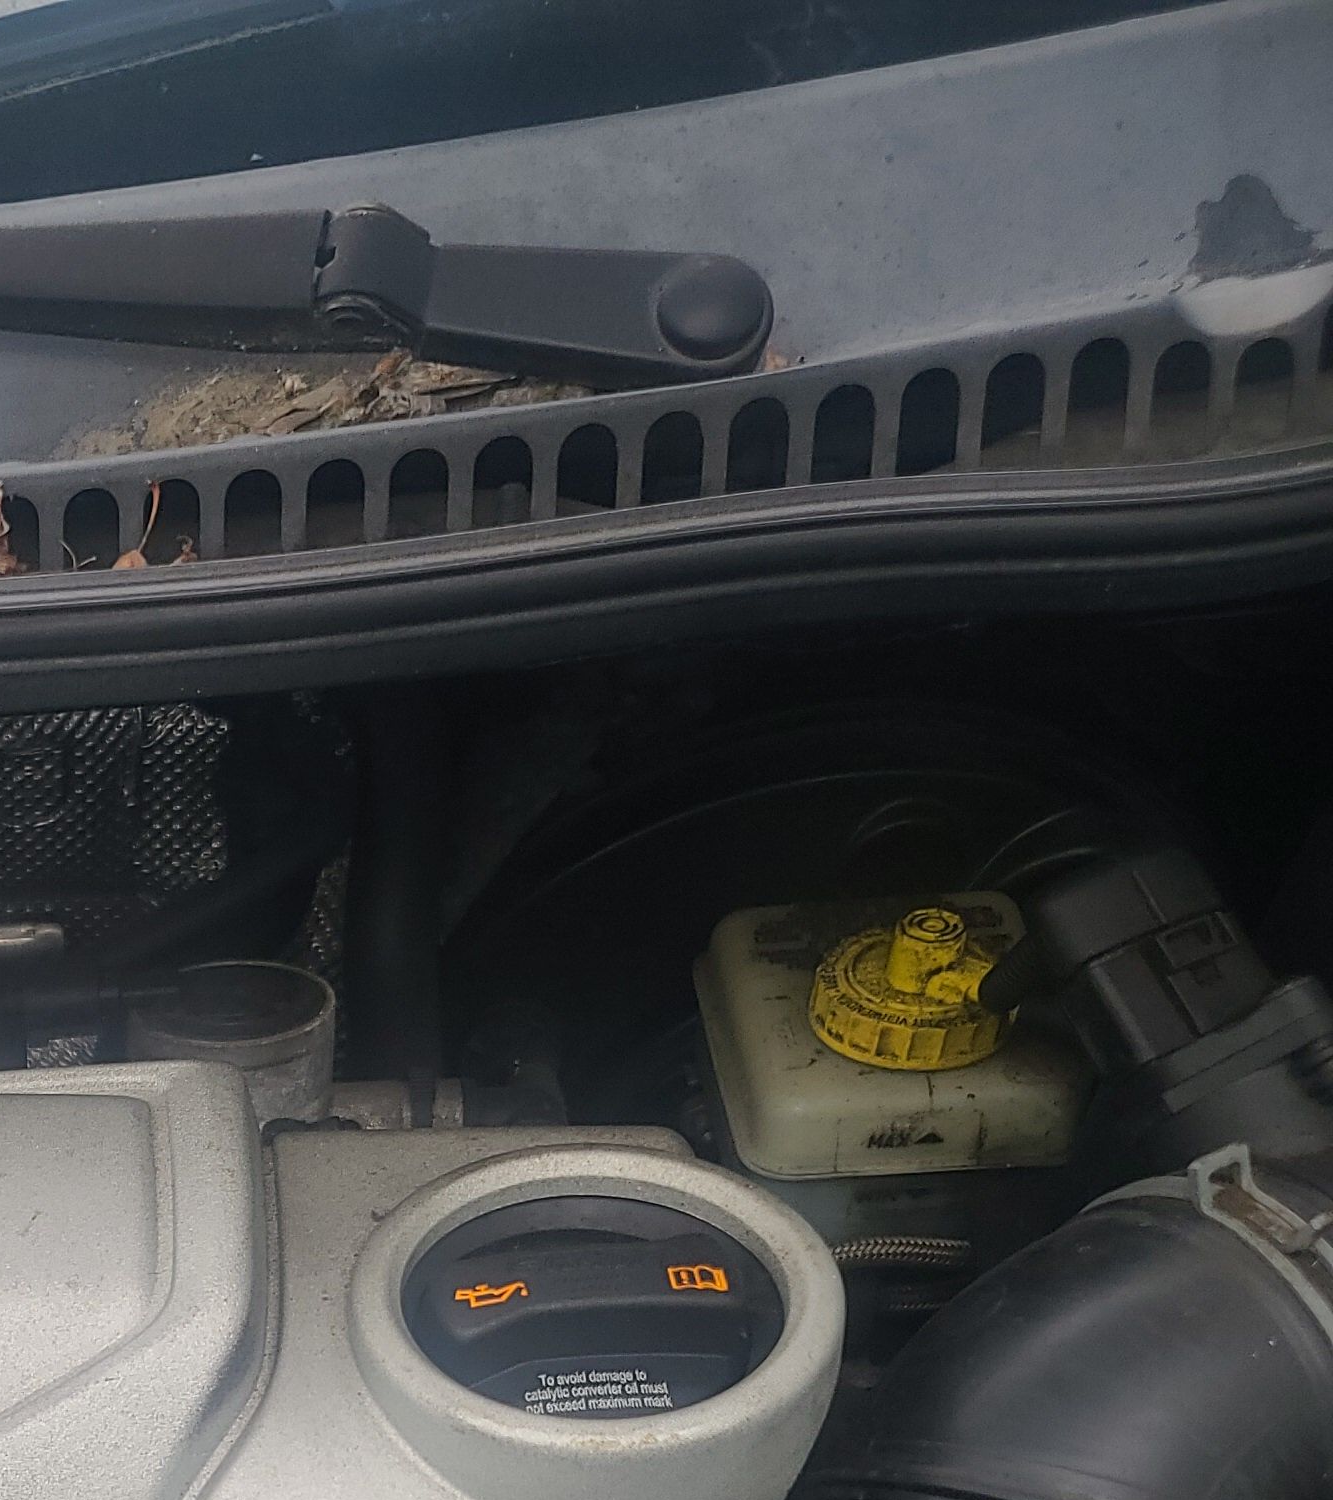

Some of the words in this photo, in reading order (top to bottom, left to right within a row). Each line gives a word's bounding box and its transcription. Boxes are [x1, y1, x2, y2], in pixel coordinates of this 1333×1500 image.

[538, 1373, 554, 1387] To
[557, 1371, 587, 1386] avoid
[588, 1370, 633, 1385] damage
[635, 1368, 647, 1382] to
[524, 1386, 569, 1402] catalytic
[571, 1383, 623, 1398] converter
[625, 1382, 639, 1394] oil
[640, 1382, 669, 1395] must
[525, 1401, 545, 1415] not
[546, 1397, 586, 1413] exceed
[588, 1396, 642, 1410] maximum
[644, 1394, 673, 1408] mark
